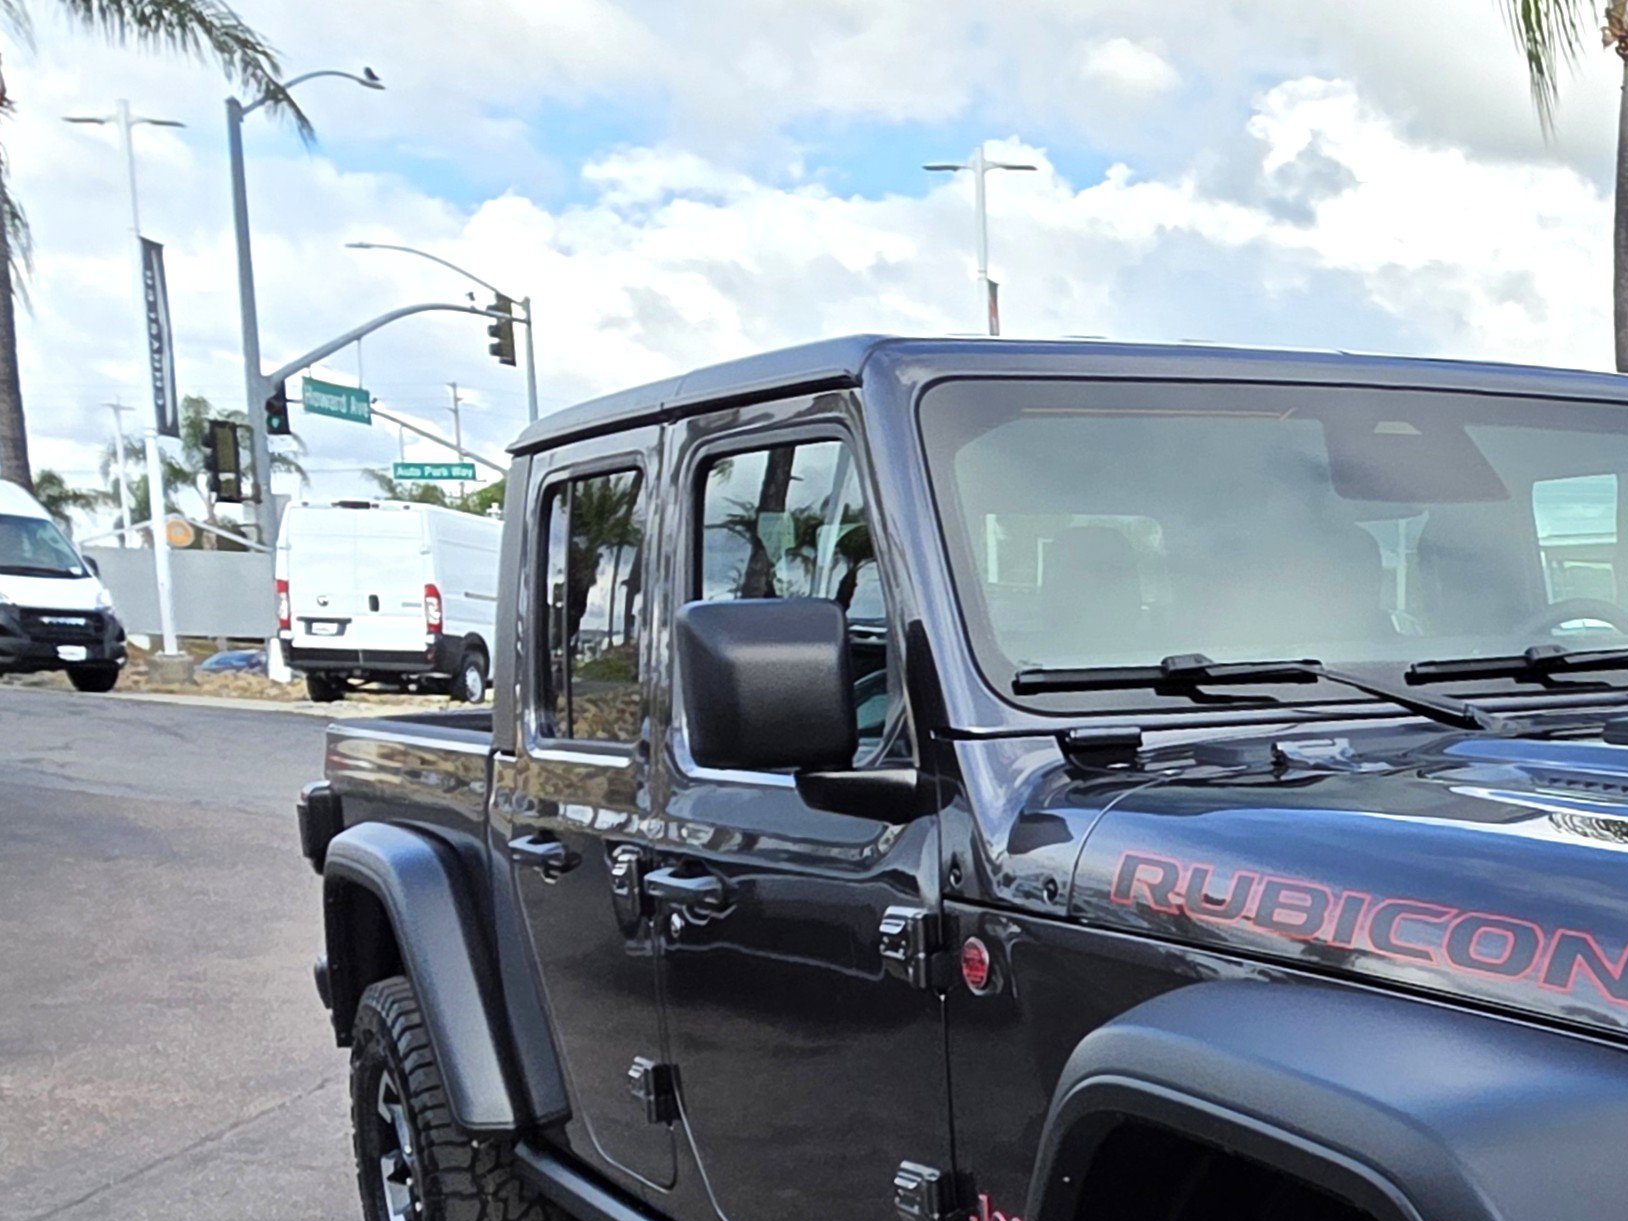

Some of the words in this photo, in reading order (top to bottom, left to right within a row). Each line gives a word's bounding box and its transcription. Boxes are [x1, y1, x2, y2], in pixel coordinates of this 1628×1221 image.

[304, 385, 347, 413] Howard
[350, 395, 369, 418] Ave
[396, 466, 421, 477] Auto
[424, 465, 448, 477] Park
[452, 466, 473, 478] Way
